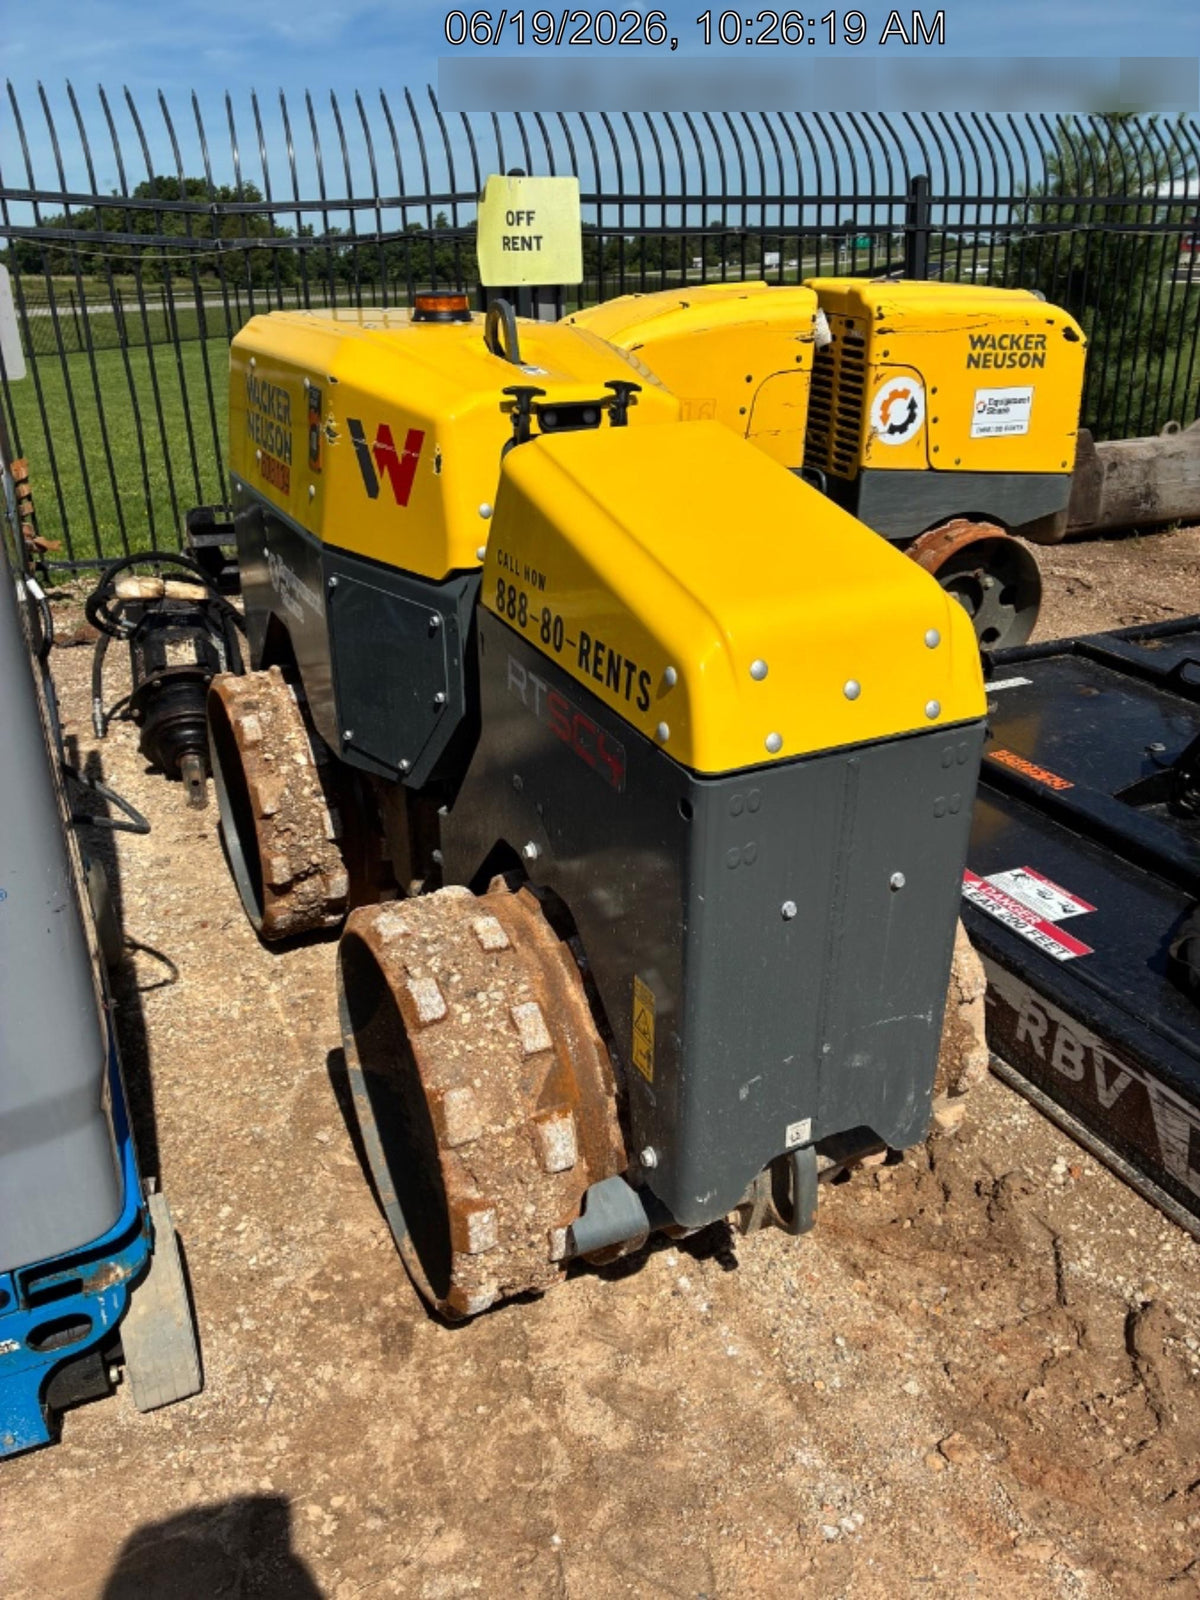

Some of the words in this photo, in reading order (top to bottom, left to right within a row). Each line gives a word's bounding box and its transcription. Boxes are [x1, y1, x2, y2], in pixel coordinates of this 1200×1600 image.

[505, 210, 536, 227] OFF
[502, 236, 544, 252] RENT
[968, 333, 1047, 351] WACKER
[966, 352, 1047, 370] NEUSON
[245, 372, 292, 428] WACKER
[246, 407, 293, 467] NEUSON
[497, 548, 521, 577] CALL
[496, 577, 652, 713] 888-80-RENTS
[999, 910, 1029, 930] 200
[1026, 930, 1071, 955] FEET
